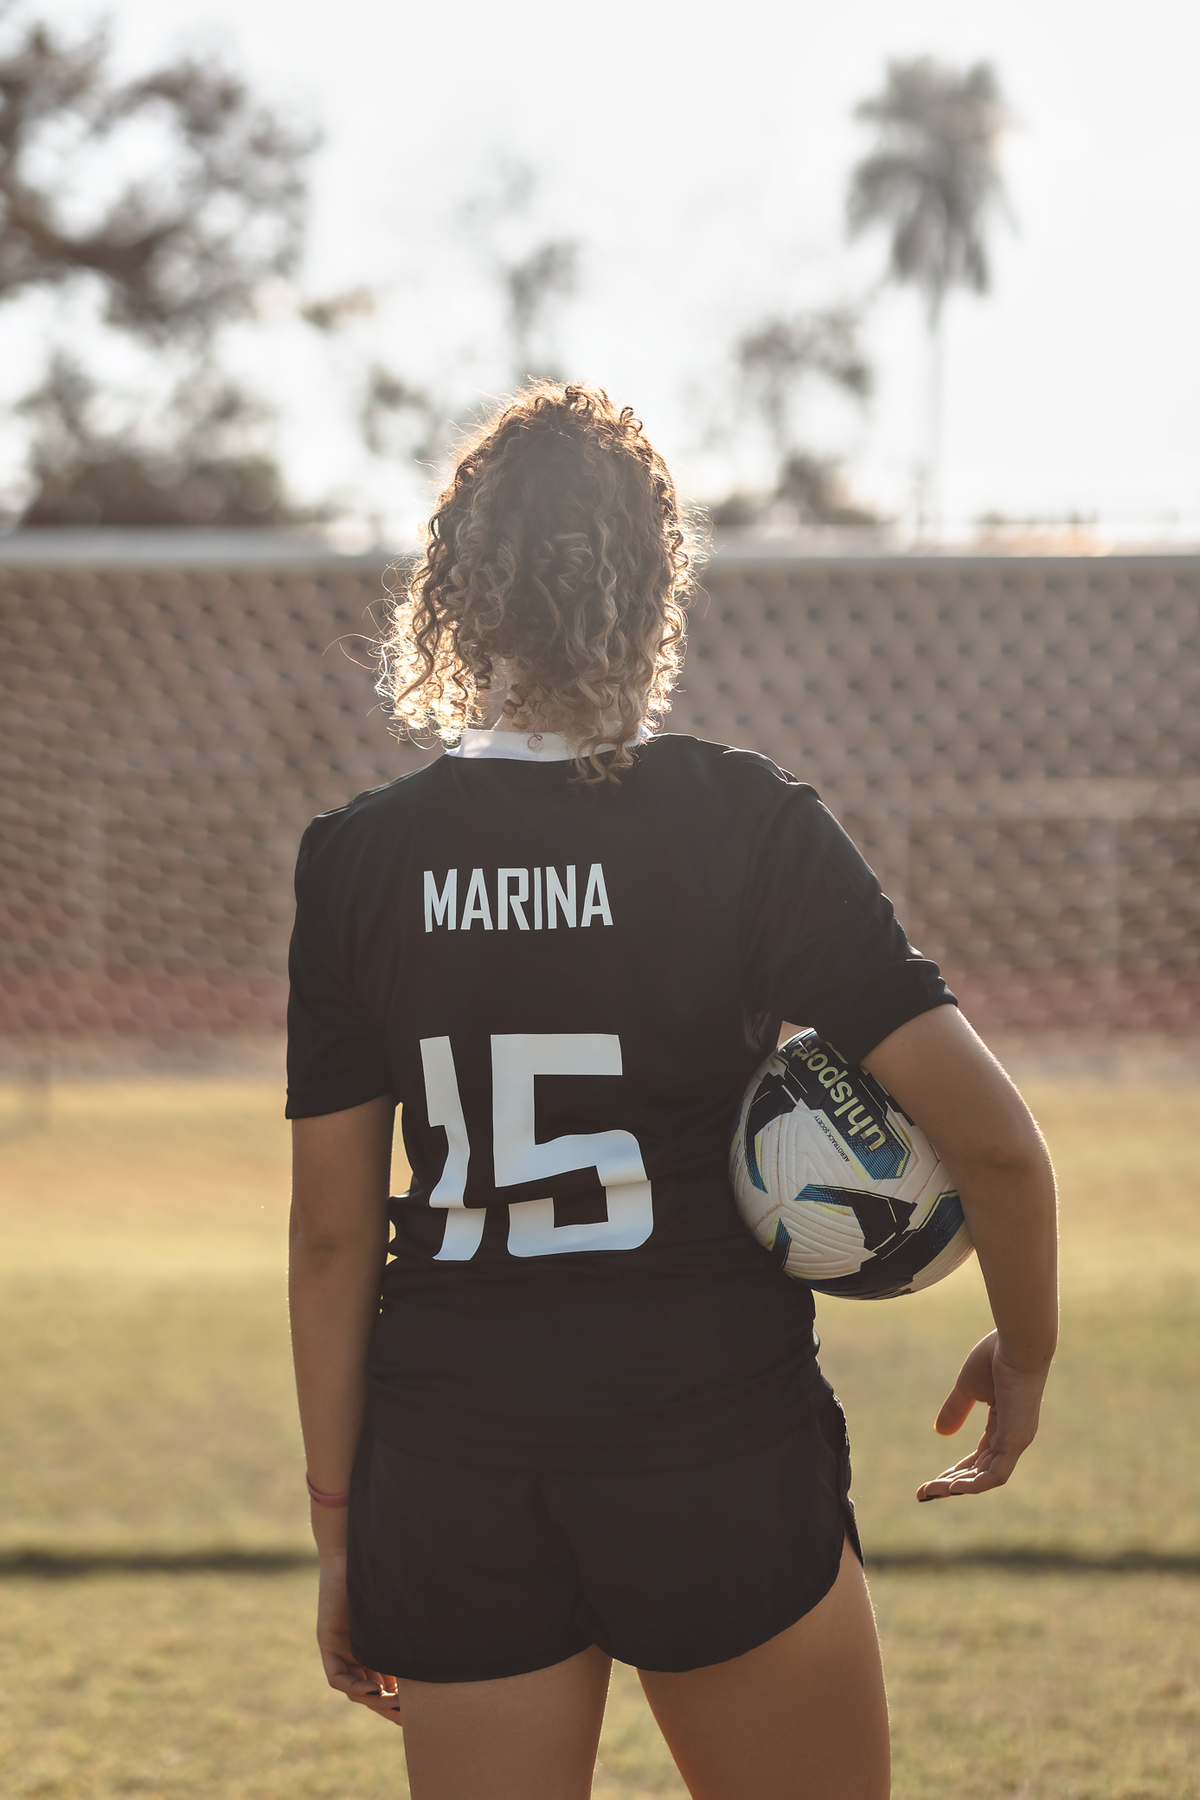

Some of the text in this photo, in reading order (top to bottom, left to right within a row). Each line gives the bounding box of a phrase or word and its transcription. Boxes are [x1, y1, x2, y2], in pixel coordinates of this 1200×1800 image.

[423, 863, 614, 933] MARINA
[791, 1039, 887, 1152] uhlsport
[813, 1115, 850, 1163] AEROTRACK SOCIETY
[419, 1033, 654, 1261] 15
